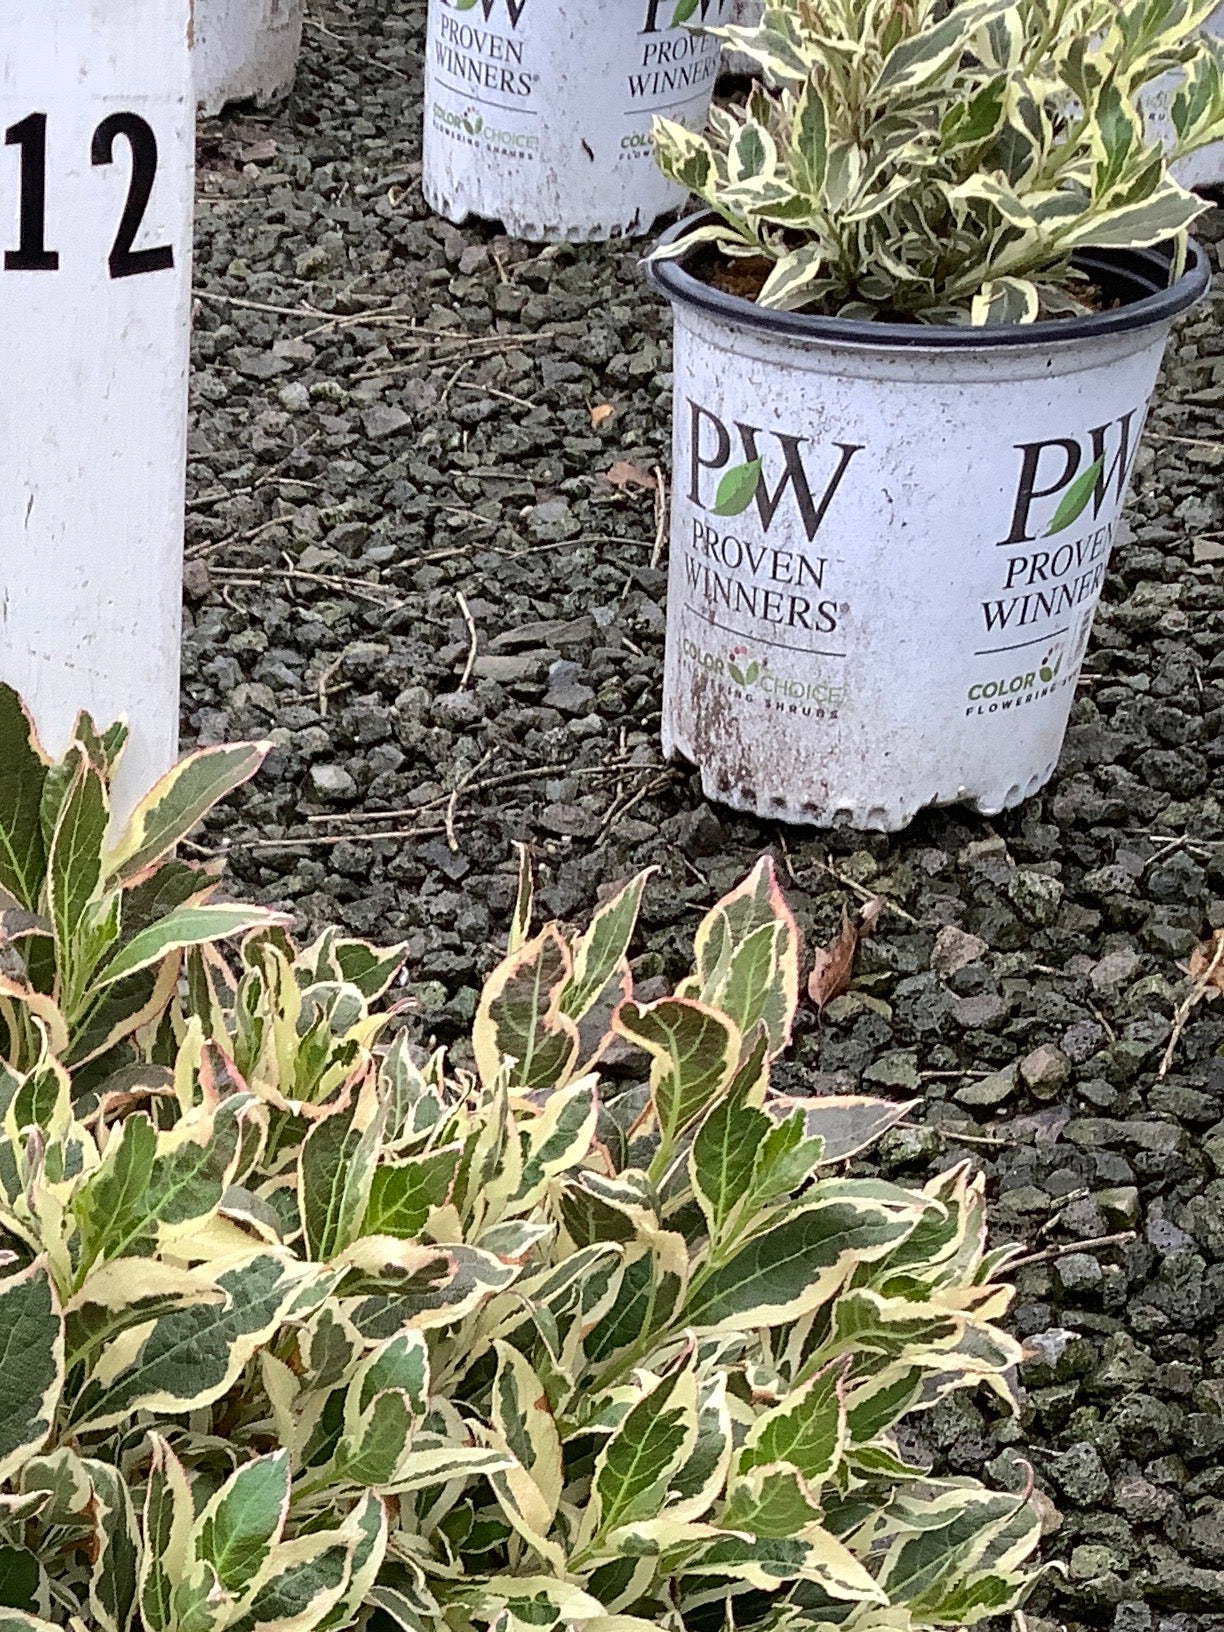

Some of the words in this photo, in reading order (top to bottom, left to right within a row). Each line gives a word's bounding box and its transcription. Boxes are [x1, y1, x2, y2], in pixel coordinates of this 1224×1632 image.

[441, 13, 524, 65] PROVEN
[3, 111, 175, 280] 12
[685, 396, 866, 543] PW
[692, 516, 828, 590] PROVEN
[981, 562, 1104, 632] WINNER
[682, 638, 725, 676] COLOR
[968, 671, 1036, 701] COLOR
